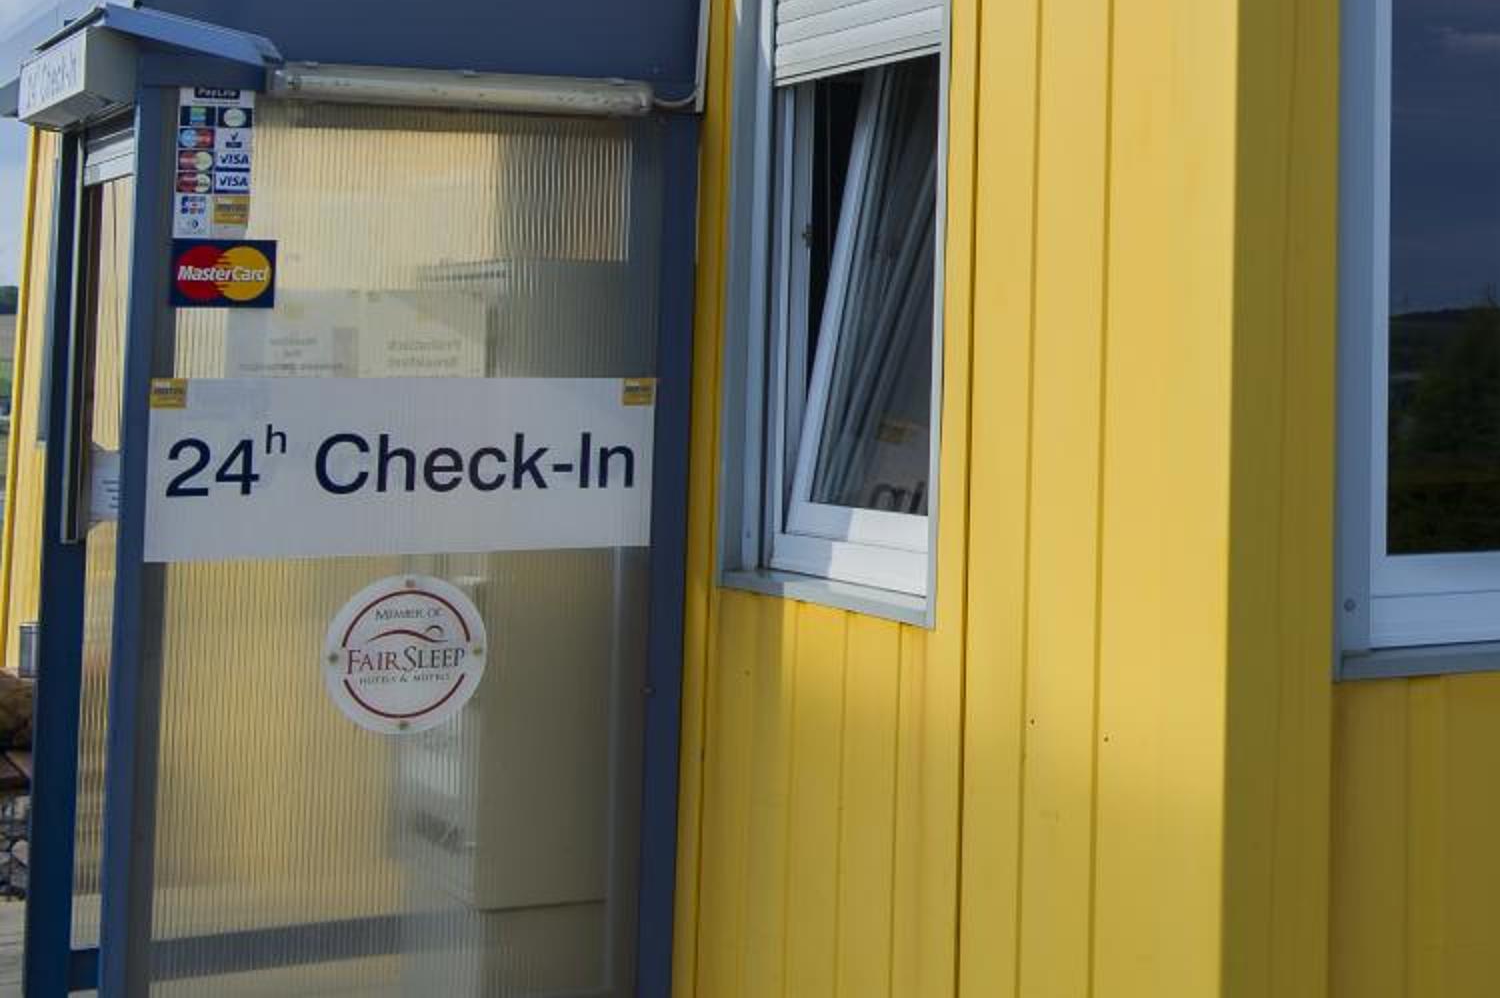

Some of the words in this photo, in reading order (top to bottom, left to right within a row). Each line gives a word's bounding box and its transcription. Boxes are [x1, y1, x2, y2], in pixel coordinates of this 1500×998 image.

[220, 153, 249, 165] VISA
[219, 175, 249, 187] VISA
[177, 265, 269, 282] MasterCard
[315, 432, 635, 495] Check-In
